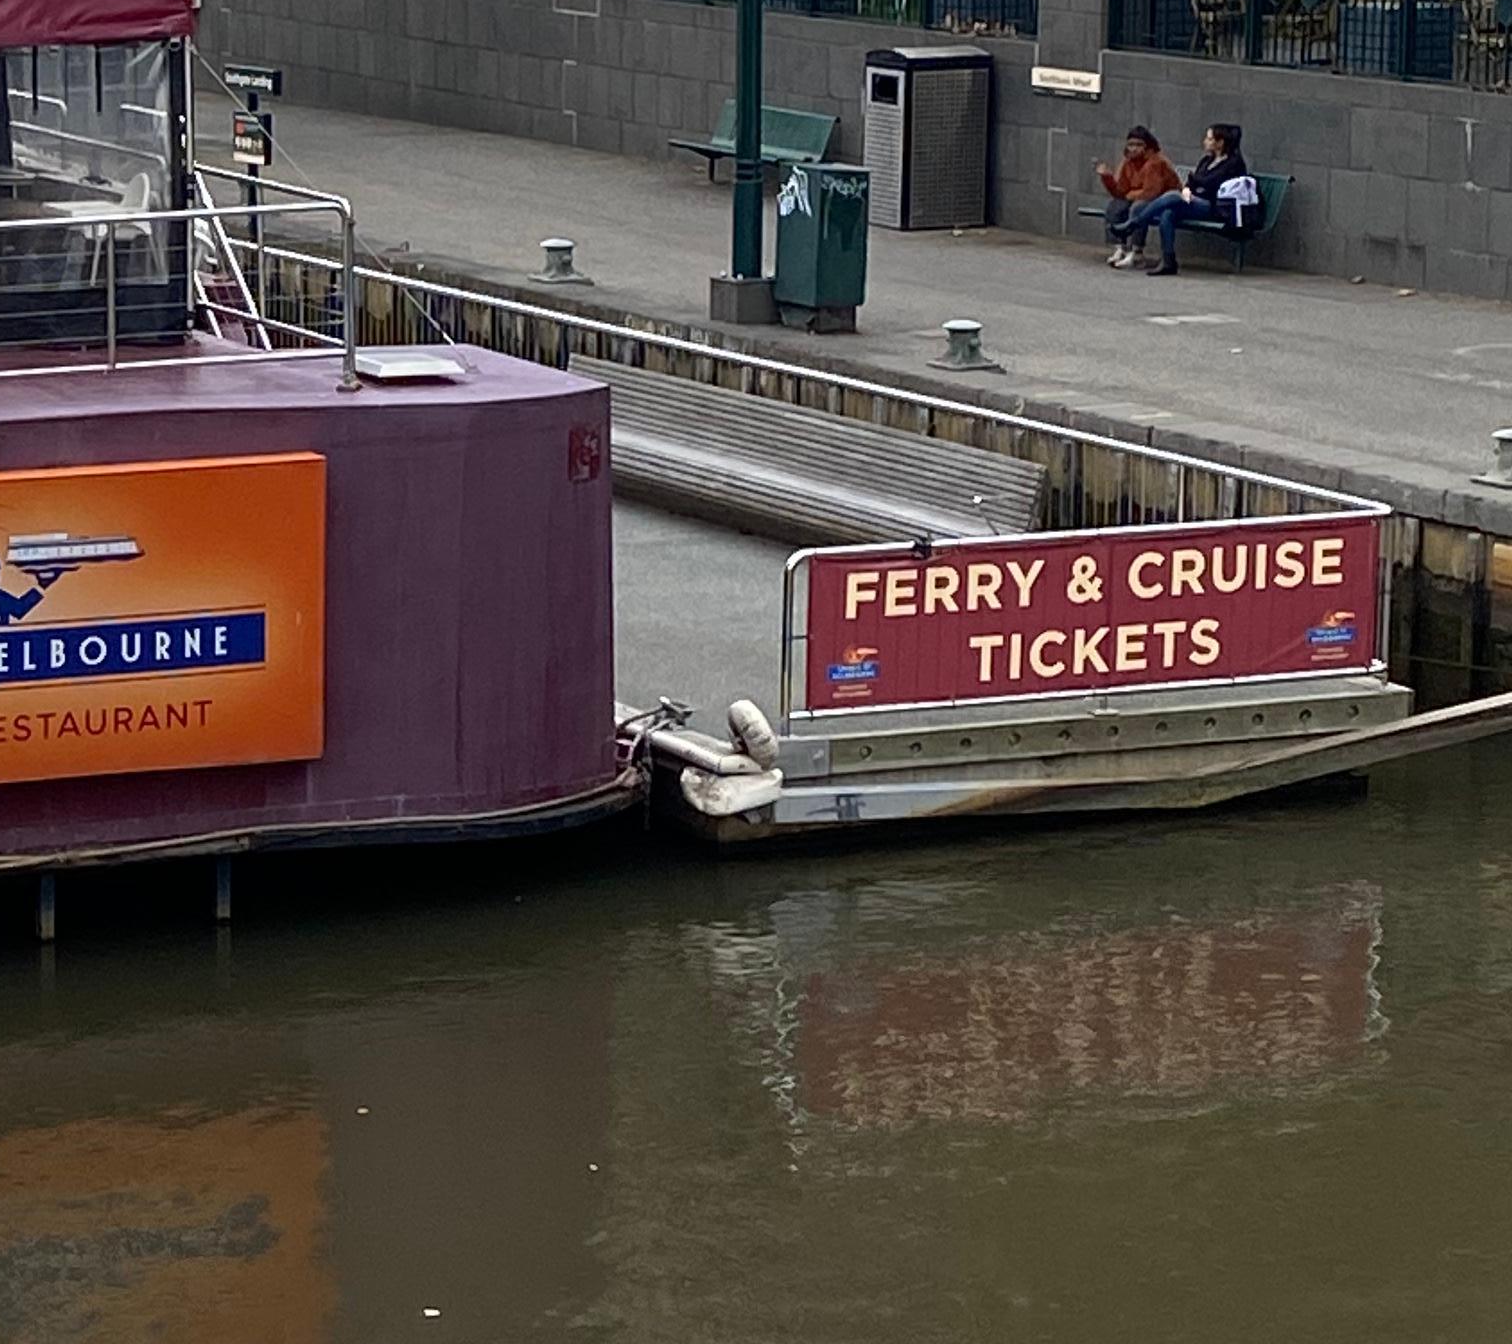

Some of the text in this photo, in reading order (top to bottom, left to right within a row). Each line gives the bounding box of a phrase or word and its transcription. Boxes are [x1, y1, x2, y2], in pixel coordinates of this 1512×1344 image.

[844, 538, 1346, 620] FERRY & CRUISE
[968, 618, 1221, 684] TICKETS
